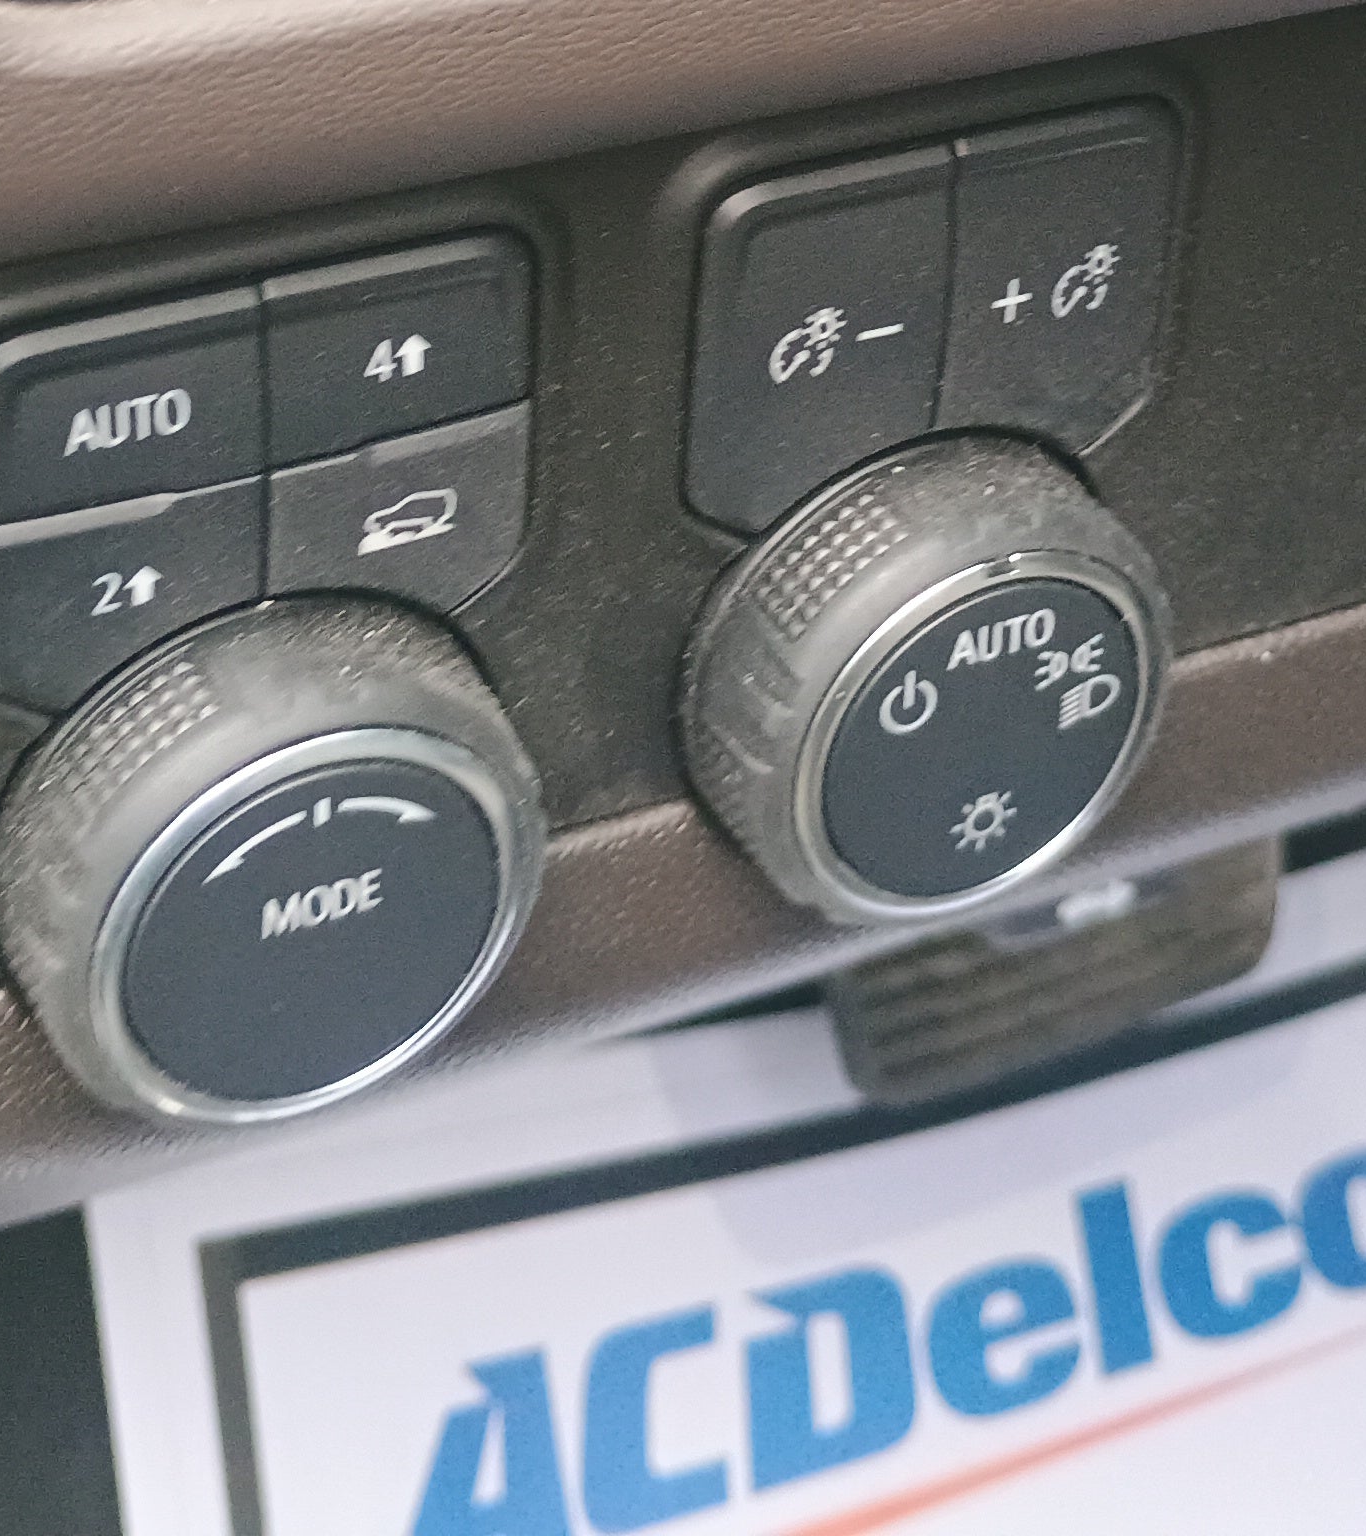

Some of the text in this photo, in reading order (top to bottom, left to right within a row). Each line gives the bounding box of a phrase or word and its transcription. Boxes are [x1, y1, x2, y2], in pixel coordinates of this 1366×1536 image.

[62, 388, 192, 457] AUTO
[947, 608, 1056, 670] AUTO
[259, 868, 383, 940] MODE
